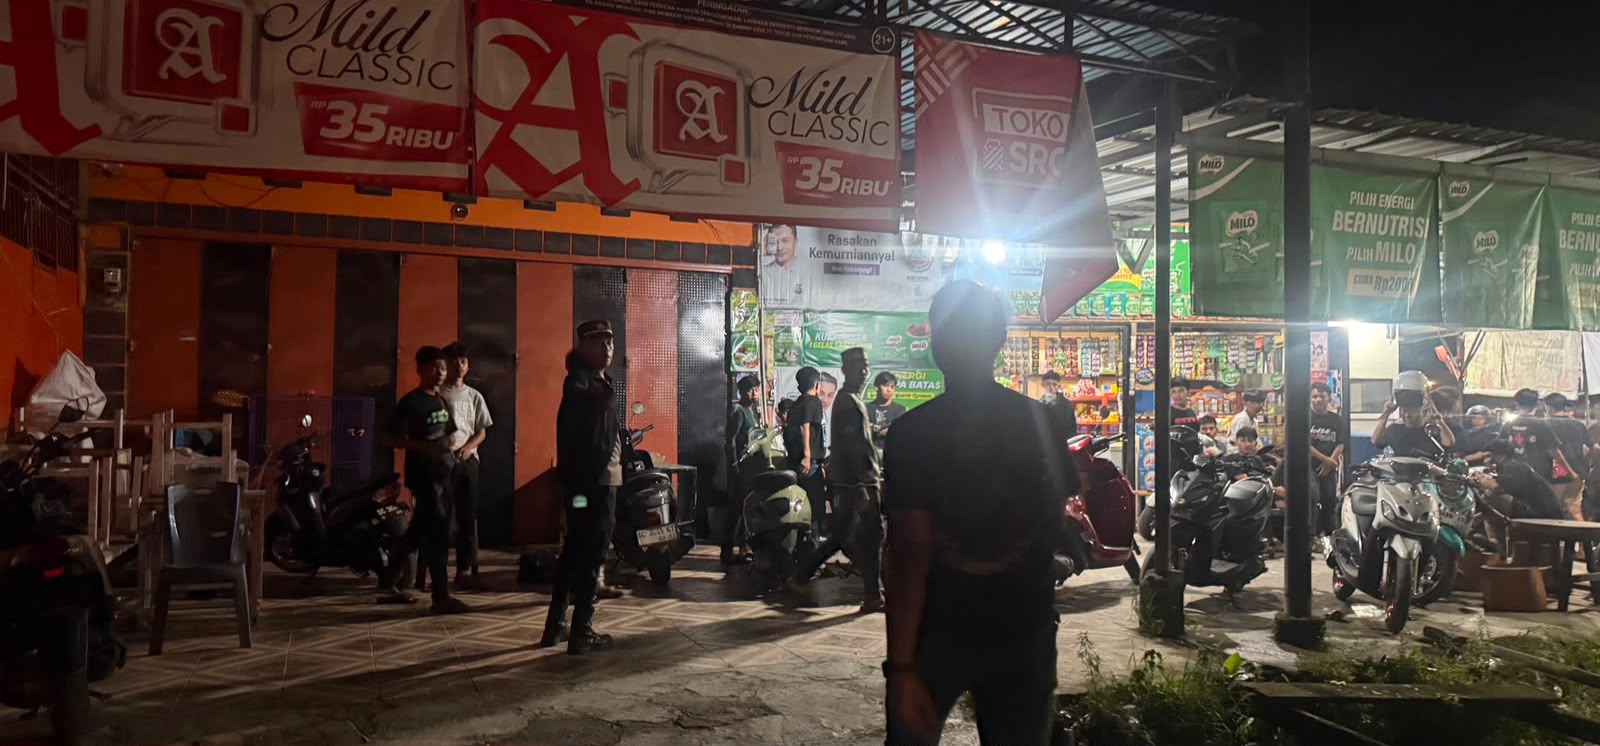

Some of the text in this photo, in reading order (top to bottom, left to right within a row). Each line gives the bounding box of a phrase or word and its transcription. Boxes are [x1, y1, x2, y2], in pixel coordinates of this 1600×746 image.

[260, 0, 432, 54] Mild
[874, 33, 893, 46] 21+
[286, 44, 456, 90] CLASSIC
[748, 66, 873, 117] Mild
[319, 100, 389, 144] 35
[768, 110, 890, 147] CLASSIC
[991, 107, 1064, 139] TOKO
[787, 156, 800, 165] RP
[794, 156, 844, 192] 35
[1200, 160, 1222, 169] MILO
[1350, 191, 1415, 210] PILIH ENERGI
[1230, 217, 1255, 230] MILO
[1571, 212, 1594, 226] PILIH
[827, 234, 877, 247] Rasakan
[1476, 237, 1496, 249] MILO
[809, 246, 896, 264] Kemurniannya!
[1346, 241, 1416, 265] PILIH MILO
[907, 380, 942, 390] BATAS
